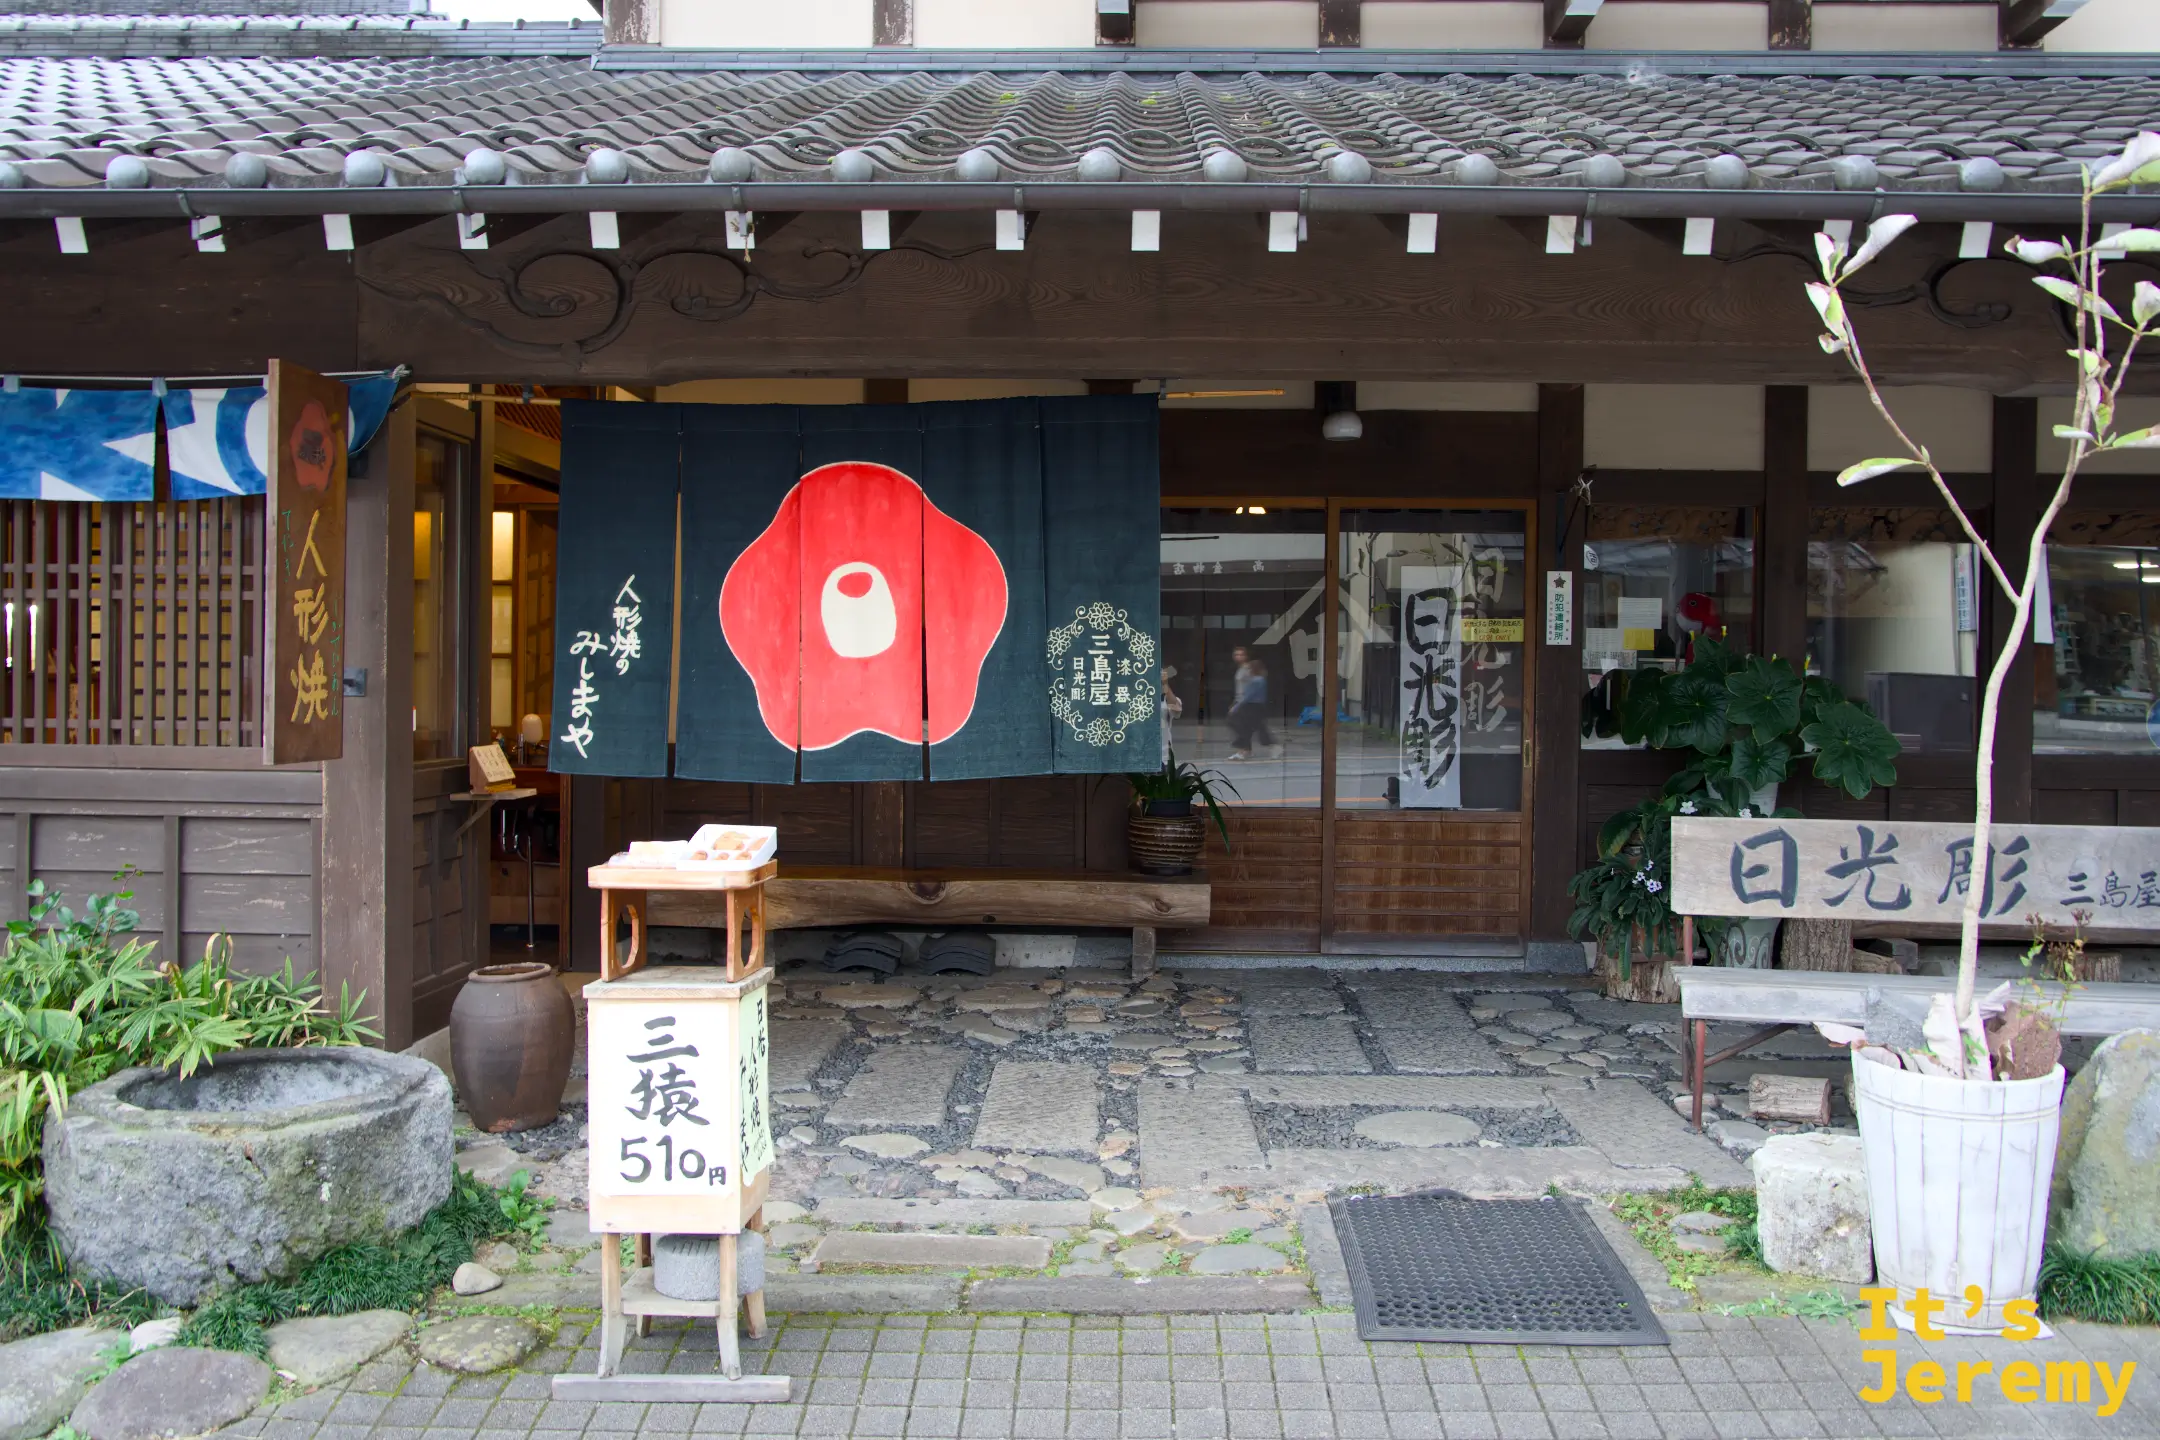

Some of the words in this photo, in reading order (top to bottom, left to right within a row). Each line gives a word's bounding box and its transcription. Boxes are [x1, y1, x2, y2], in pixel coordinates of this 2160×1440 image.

[290, 509, 330, 725] 人形焼
[609, 573, 643, 677] 人形焼の
[559, 630, 609, 760] みしまや
[1071, 656, 1087, 701] 日光彫
[1087, 633, 1114, 706] 三島屋
[1114, 657, 1132, 703] 漆器
[1404, 586, 1458, 790] 日光彫
[1730, 824, 2030, 920] 日光彫
[2060, 869, 2160, 909] 三島屋
[625, 1015, 711, 1128] 三猿
[619, 1134, 727, 1187] 510円
